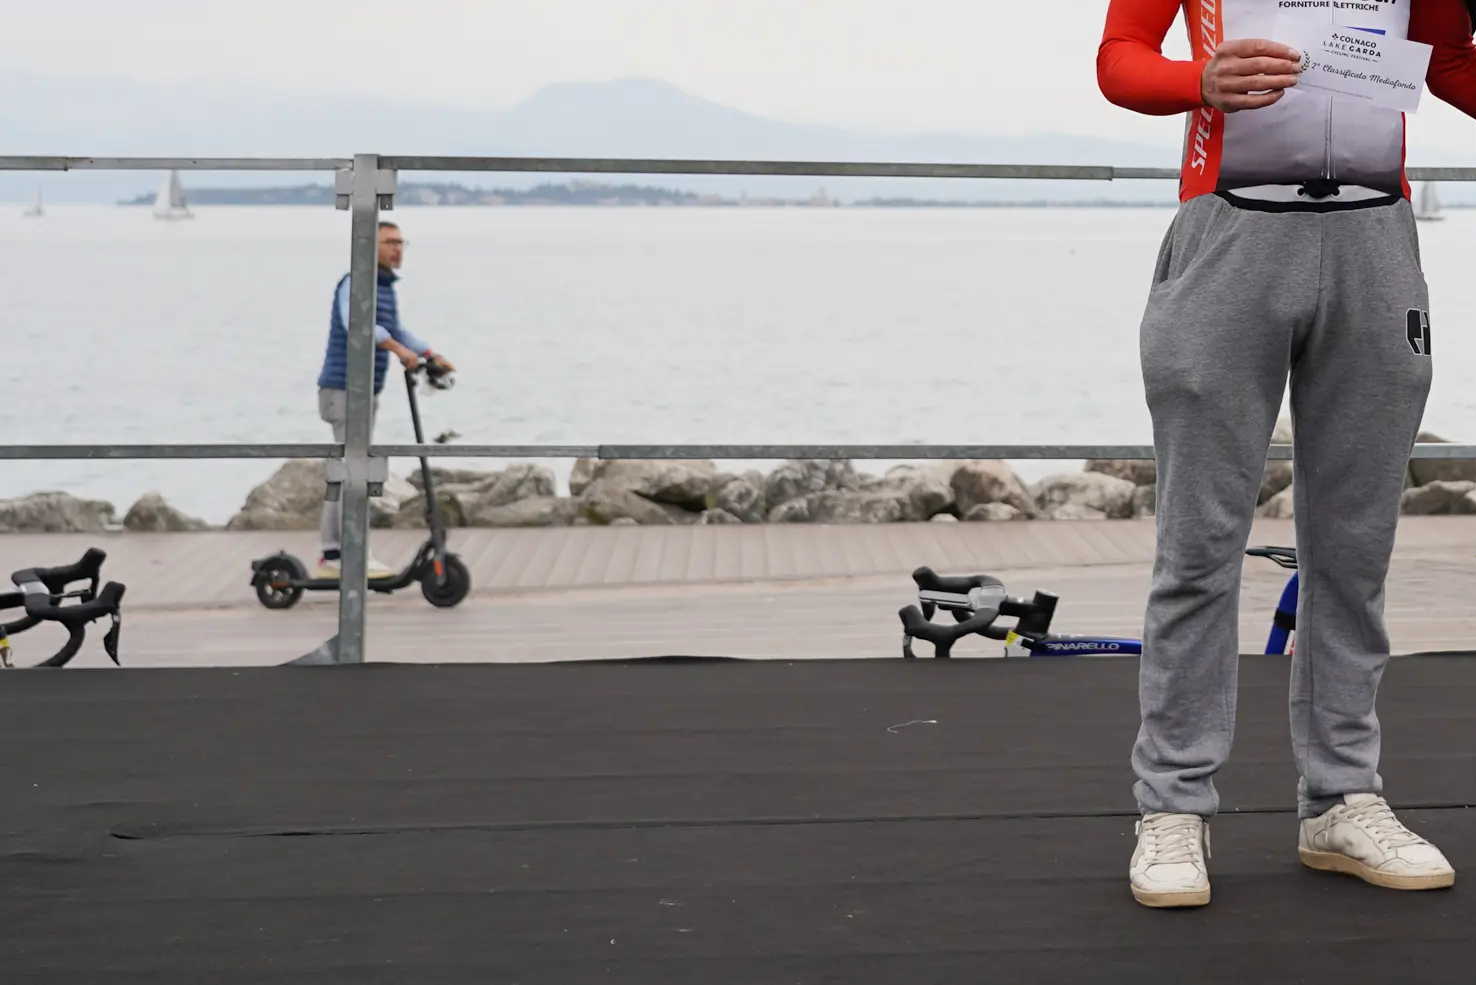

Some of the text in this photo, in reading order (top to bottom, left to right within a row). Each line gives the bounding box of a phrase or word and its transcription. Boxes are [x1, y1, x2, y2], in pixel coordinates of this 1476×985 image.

[1278, 0, 1330, 9] FORNITURE
[1323, 40, 1382, 58] LAKE GARDA
[1339, 35, 1377, 49] COLNAGO
[1322, 64, 1367, 79] Classificato
[1369, 74, 1417, 91] Mediofondo
[1045, 642, 1121, 651] PINARELLO
